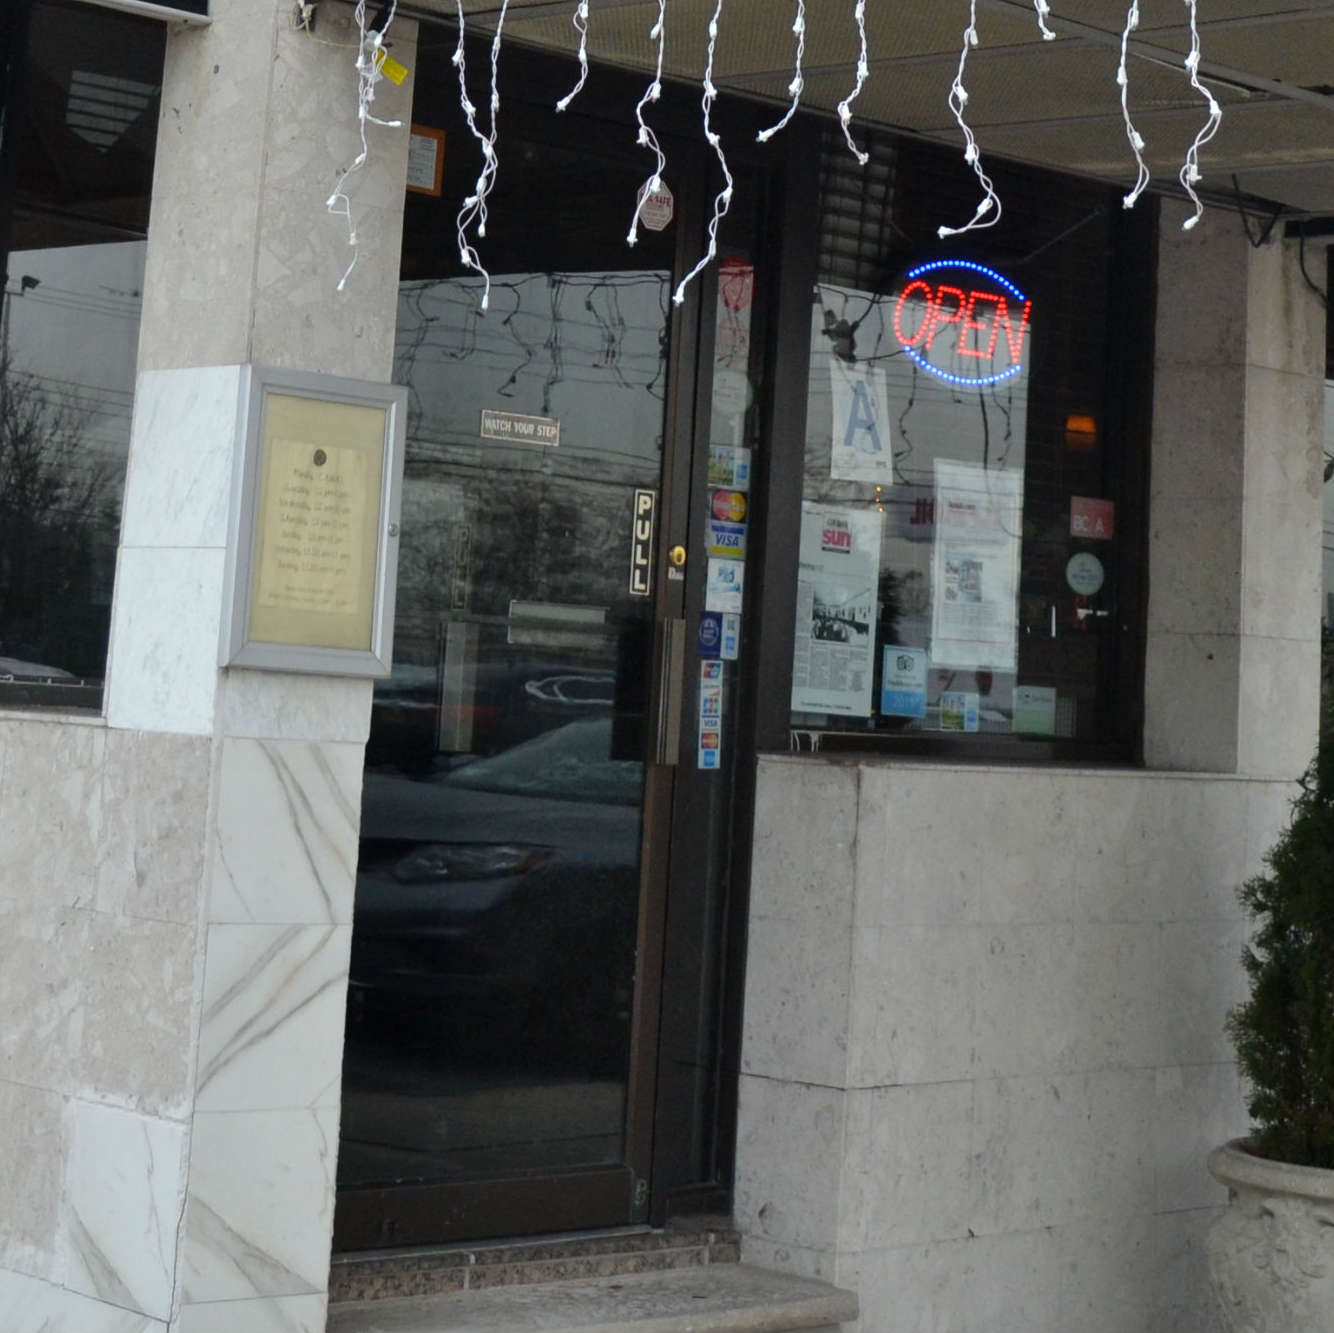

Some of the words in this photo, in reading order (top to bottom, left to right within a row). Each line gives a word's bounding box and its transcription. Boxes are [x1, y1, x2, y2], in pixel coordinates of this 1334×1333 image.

[894, 280, 1033, 364] OPEN
[843, 379, 883, 452] A
[484, 418, 512, 432] WATCH
[514, 421, 535, 436] YOUR
[537, 424, 557, 438] STEP
[633, 495, 652, 591] PULL
[715, 533, 741, 547] VISA
[822, 529, 852, 548] sun
[703, 720, 718, 728] VISA
